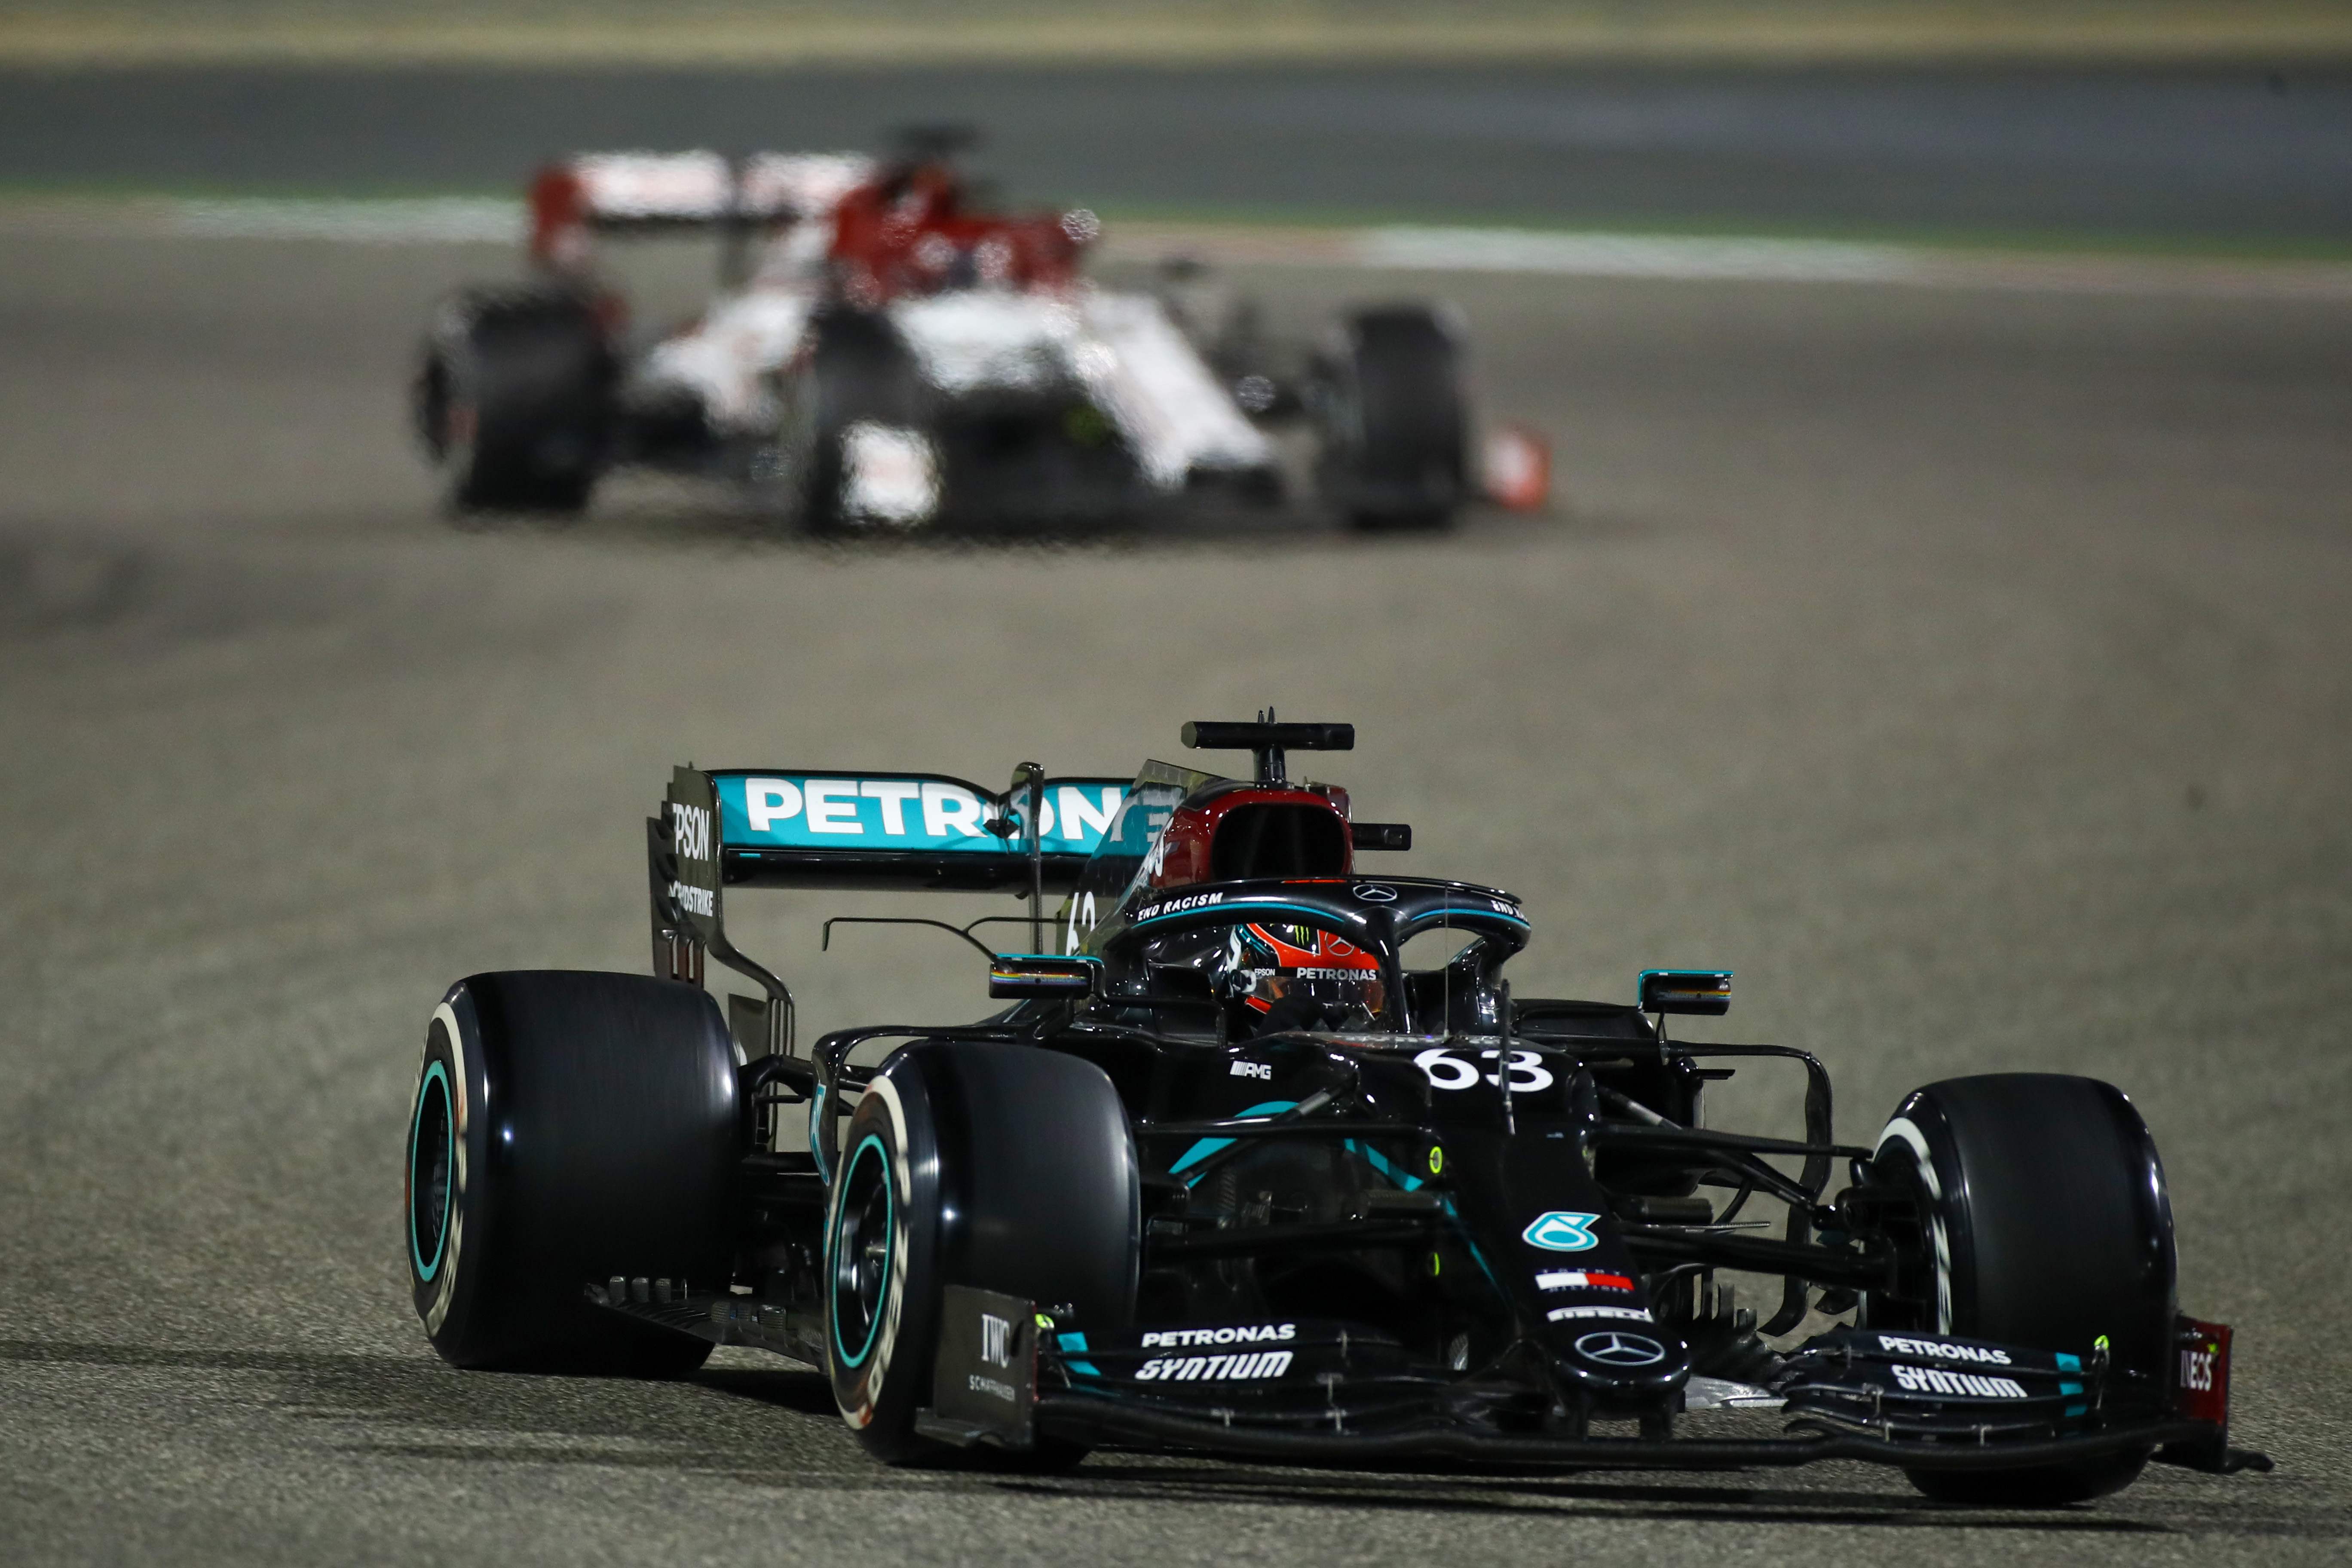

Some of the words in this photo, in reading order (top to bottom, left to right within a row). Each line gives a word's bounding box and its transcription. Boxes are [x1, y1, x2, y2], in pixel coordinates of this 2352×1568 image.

[1137, 904, 1160, 921] END
[1163, 892, 1223, 914] RACISM
[1254, 968, 1275, 976] EPSON
[1297, 967, 1376, 980] PETRONAS
[1244, 1062, 1272, 1080] AMG
[1414, 1048, 1553, 1092] 63
[982, 1314, 1010, 1368] IWC
[1141, 1323, 1295, 1348] PETRONAS
[1878, 1335, 2012, 1365] PETRONAS
[1135, 1351, 1293, 1380] SYNTIUM
[1892, 1365, 2028, 1397] SYNTIUM
